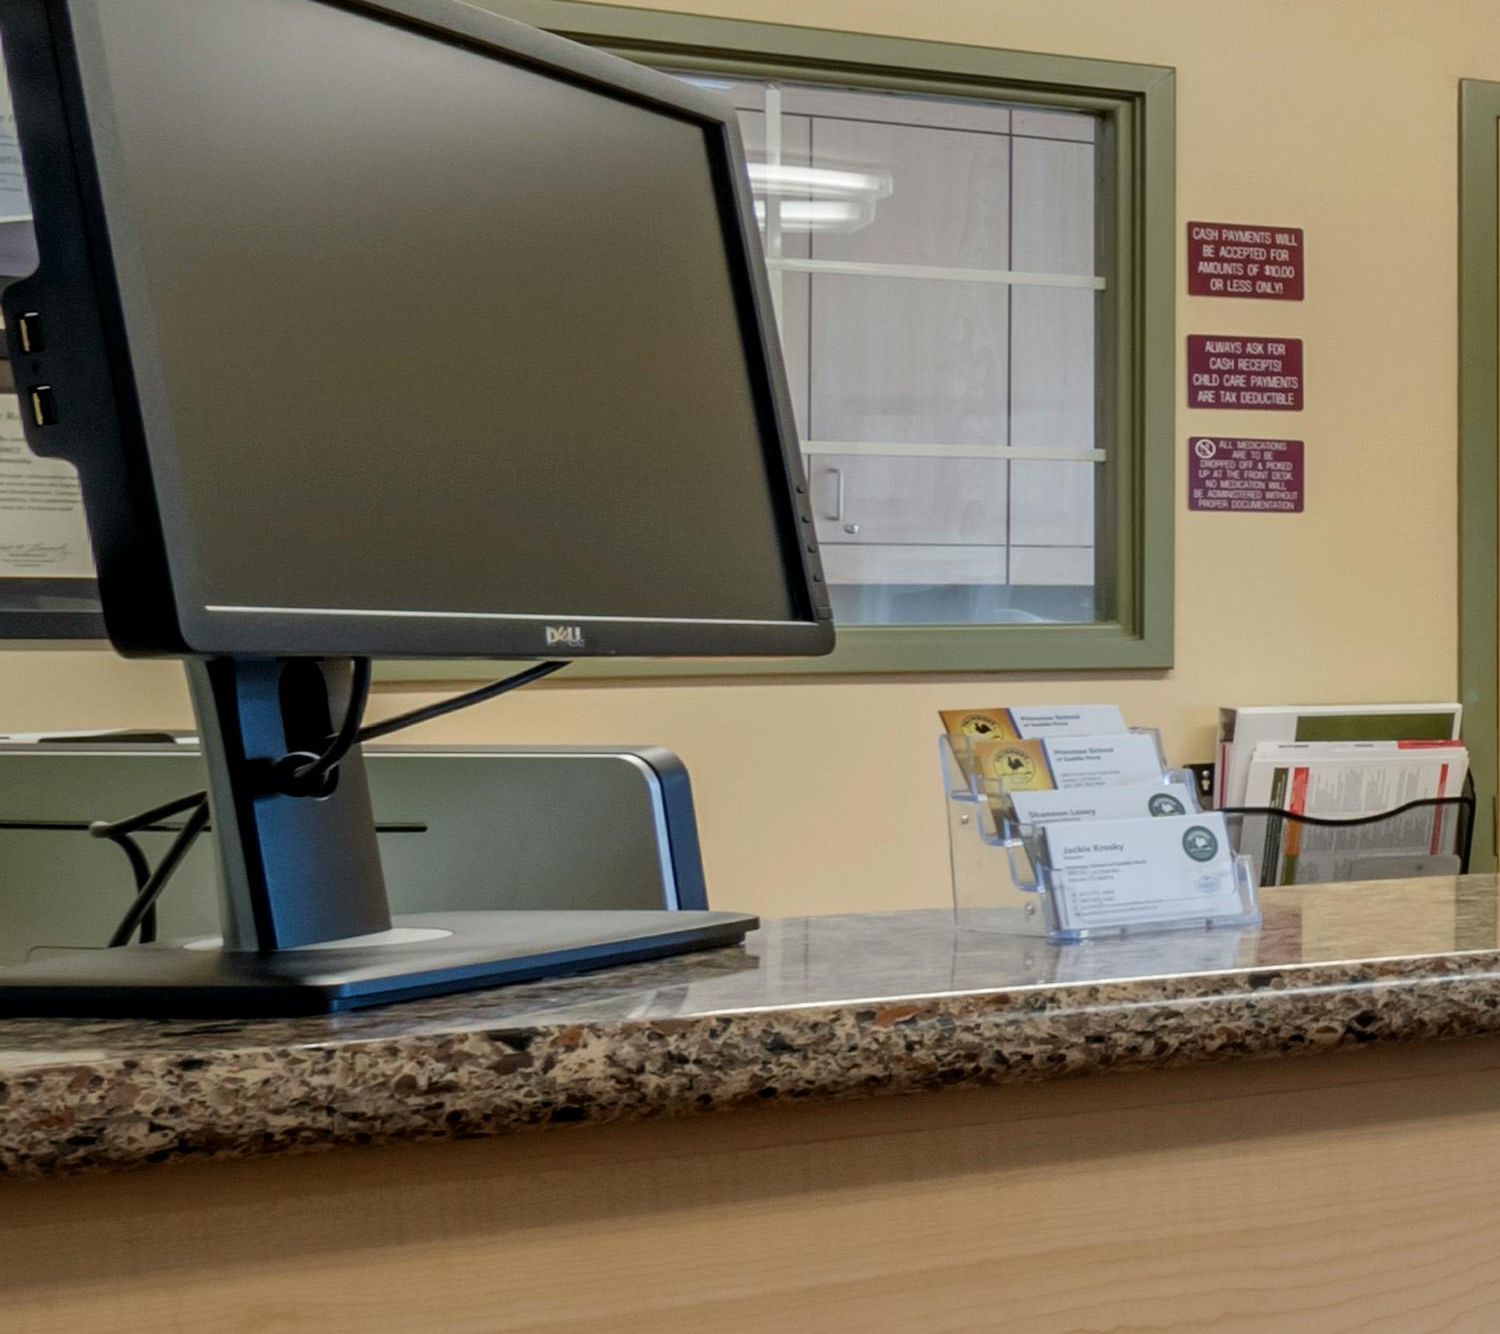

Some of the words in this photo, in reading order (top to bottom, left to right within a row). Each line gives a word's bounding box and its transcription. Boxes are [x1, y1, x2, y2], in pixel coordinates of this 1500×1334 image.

[1192, 228, 1218, 241] CASH
[1222, 229, 1271, 244] PAYMENTS
[1275, 234, 1298, 246] WILL
[1202, 245, 1215, 257] BE
[1219, 246, 1267, 260] ACCEPTED
[1271, 248, 1289, 261] FOR
[1198, 261, 1244, 276] AMOUNTS
[1248, 264, 1260, 276] OF
[1264, 265, 1295, 278] $10.00
[1210, 278, 1224, 290] OR
[1227, 279, 1252, 292] LESS
[1256, 281, 1283, 294] ONLY!
[1205, 341, 1242, 354] ALWAYS
[1246, 342, 1264, 355] ASK
[1268, 343, 1286, 356] FOR
[1209, 358, 1234, 370] CASH
[1238, 359, 1282, 372] RECEIPTS!
[1192, 374, 1219, 386] CHILD
[1224, 375, 1247, 388] CARE
[1250, 376, 1298, 389] PAYMENTS
[1197, 390, 1215, 403] ARE
[1220, 391, 1237, 404] TAX
[1240, 392, 1295, 405] DEDUCTIBLE
[1219, 441, 1233, 449] ALL
[1237, 441, 1287, 451] MEDICATIONS
[1232, 451, 1247, 459] ARE
[1251, 451, 1261, 460] TO
[1263, 451, 1274, 460] BE
[1200, 459, 1236, 469] DROPPED
[1239, 460, 1253, 469] OFF
[1266, 461, 1293, 470] PICKED
[1198, 470, 1210, 478] UP
[1212, 470, 1222, 478] AT
[1227, 470, 1240, 479] THE
[1244, 470, 1269, 480] FRONT
[1205, 479, 1217, 488] NO
[1220, 480, 1266, 489] MEDICATION
[1269, 481, 1287, 490] WILL
[1193, 489, 1204, 498] BE
[1208, 490, 1262, 499] ADMINISTERED
[1265, 491, 1298, 500] WITHOUT
[1198, 499, 1228, 508] PROPER
[1231, 500, 1295, 509] DOCUMENTATION
[545, 626, 581, 646] DELL
